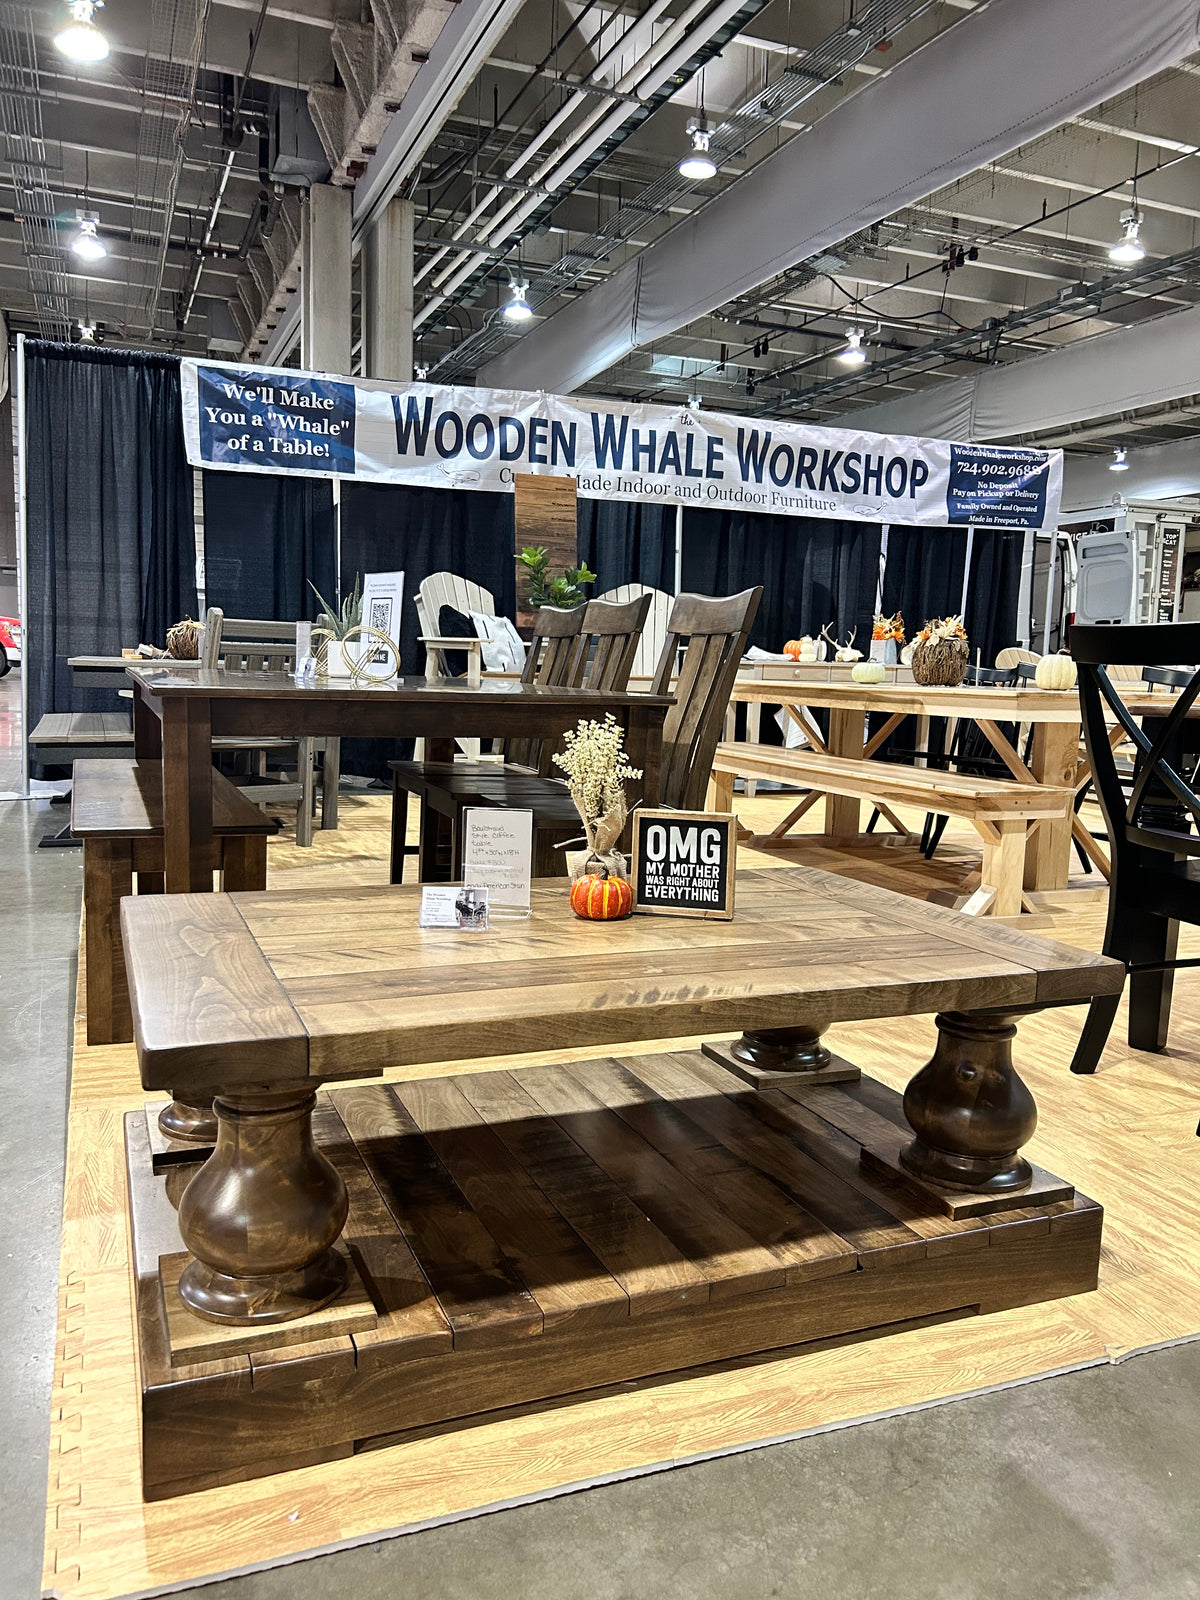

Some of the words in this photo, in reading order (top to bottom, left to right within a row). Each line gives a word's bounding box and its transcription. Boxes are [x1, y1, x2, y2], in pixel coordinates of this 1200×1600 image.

[222, 383, 274, 405] We'll
[280, 389, 335, 411] Make
[205, 407, 247, 427] You
[251, 415, 264, 427] a
[268, 411, 350, 437] "Whale"
[679, 411, 695, 427] the
[227, 434, 251, 452] of
[253, 440, 265, 453] a
[268, 437, 331, 458] Table!
[390, 394, 577, 467] WOODEN
[591, 411, 725, 479] WHALE
[737, 427, 930, 500] WORKSHOP
[957, 462, 1042, 478] 724.902.9688
[617, 475, 671, 497] Indoor
[674, 480, 702, 499] and
[707, 484, 768, 505] Outdoor
[771, 490, 836, 512] Furniture
[953, 488, 966, 497] Pay
[977, 489, 1004, 498] Pickup
[1015, 489, 1039, 500] Delivery
[977, 481, 988, 489] No
[989, 481, 1019, 491] Deposit
[956, 503, 979, 511] Family
[1013, 505, 1038, 513] Operated
[968, 515, 985, 523] Made
[986, 515, 993, 523] in
[993, 517, 1020, 525] Freeport,
[646, 825, 721, 865] OMG
[645, 861, 666, 876] MY
[670, 863, 720, 878] MOTHER
[645, 875, 665, 885] WAS
[666, 876, 691, 887] RIGHT
[692, 877, 719, 888] ABOUT
[644, 887, 719, 902] EVERYTHING
